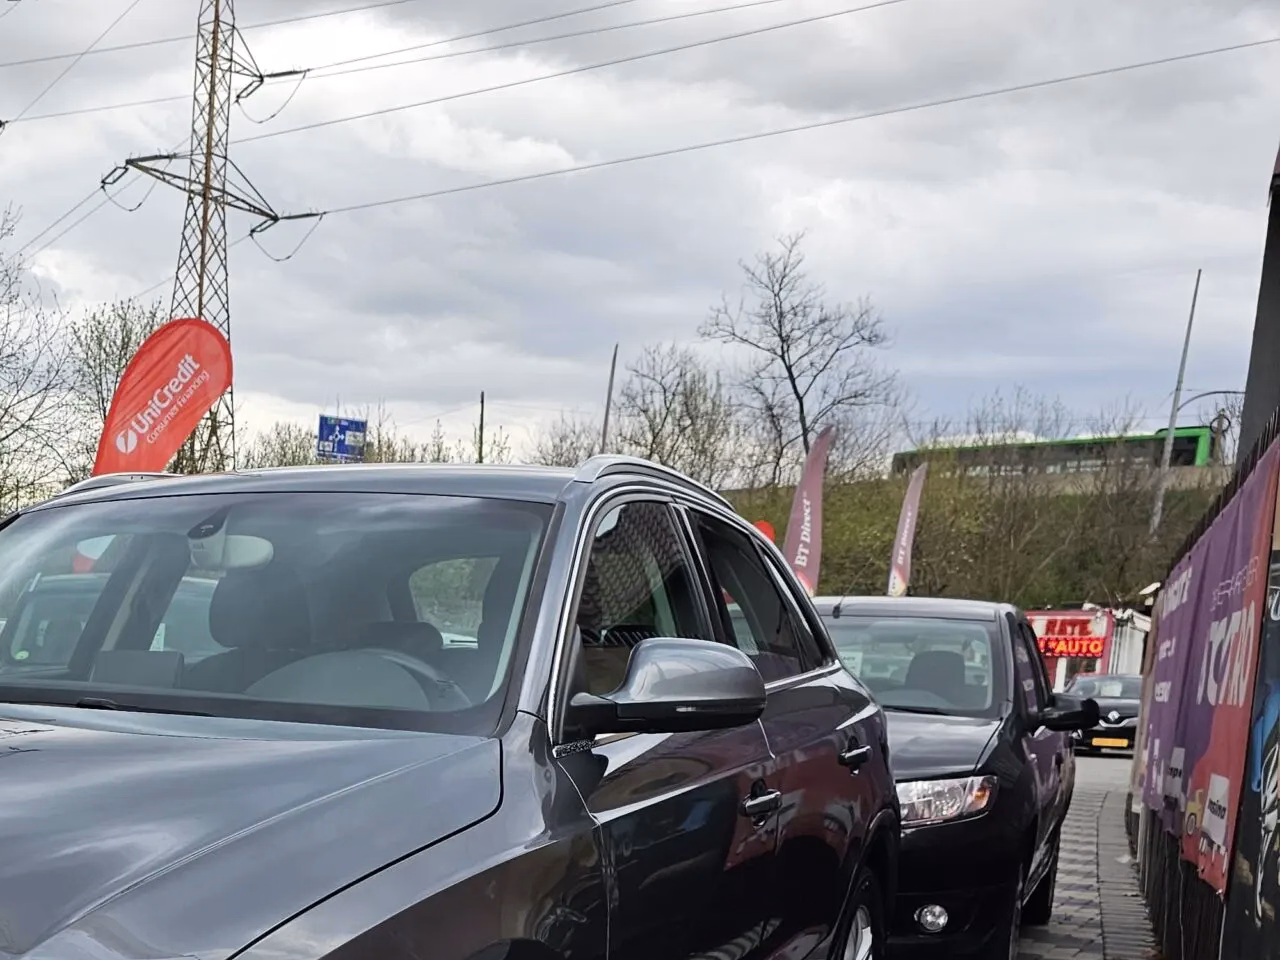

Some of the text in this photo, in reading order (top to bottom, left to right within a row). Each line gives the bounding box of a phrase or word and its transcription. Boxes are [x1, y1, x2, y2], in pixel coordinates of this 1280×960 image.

[131, 354, 200, 433] UniCredit
[147, 370, 210, 444] Consumer Financing
[794, 543, 810, 567] BT
